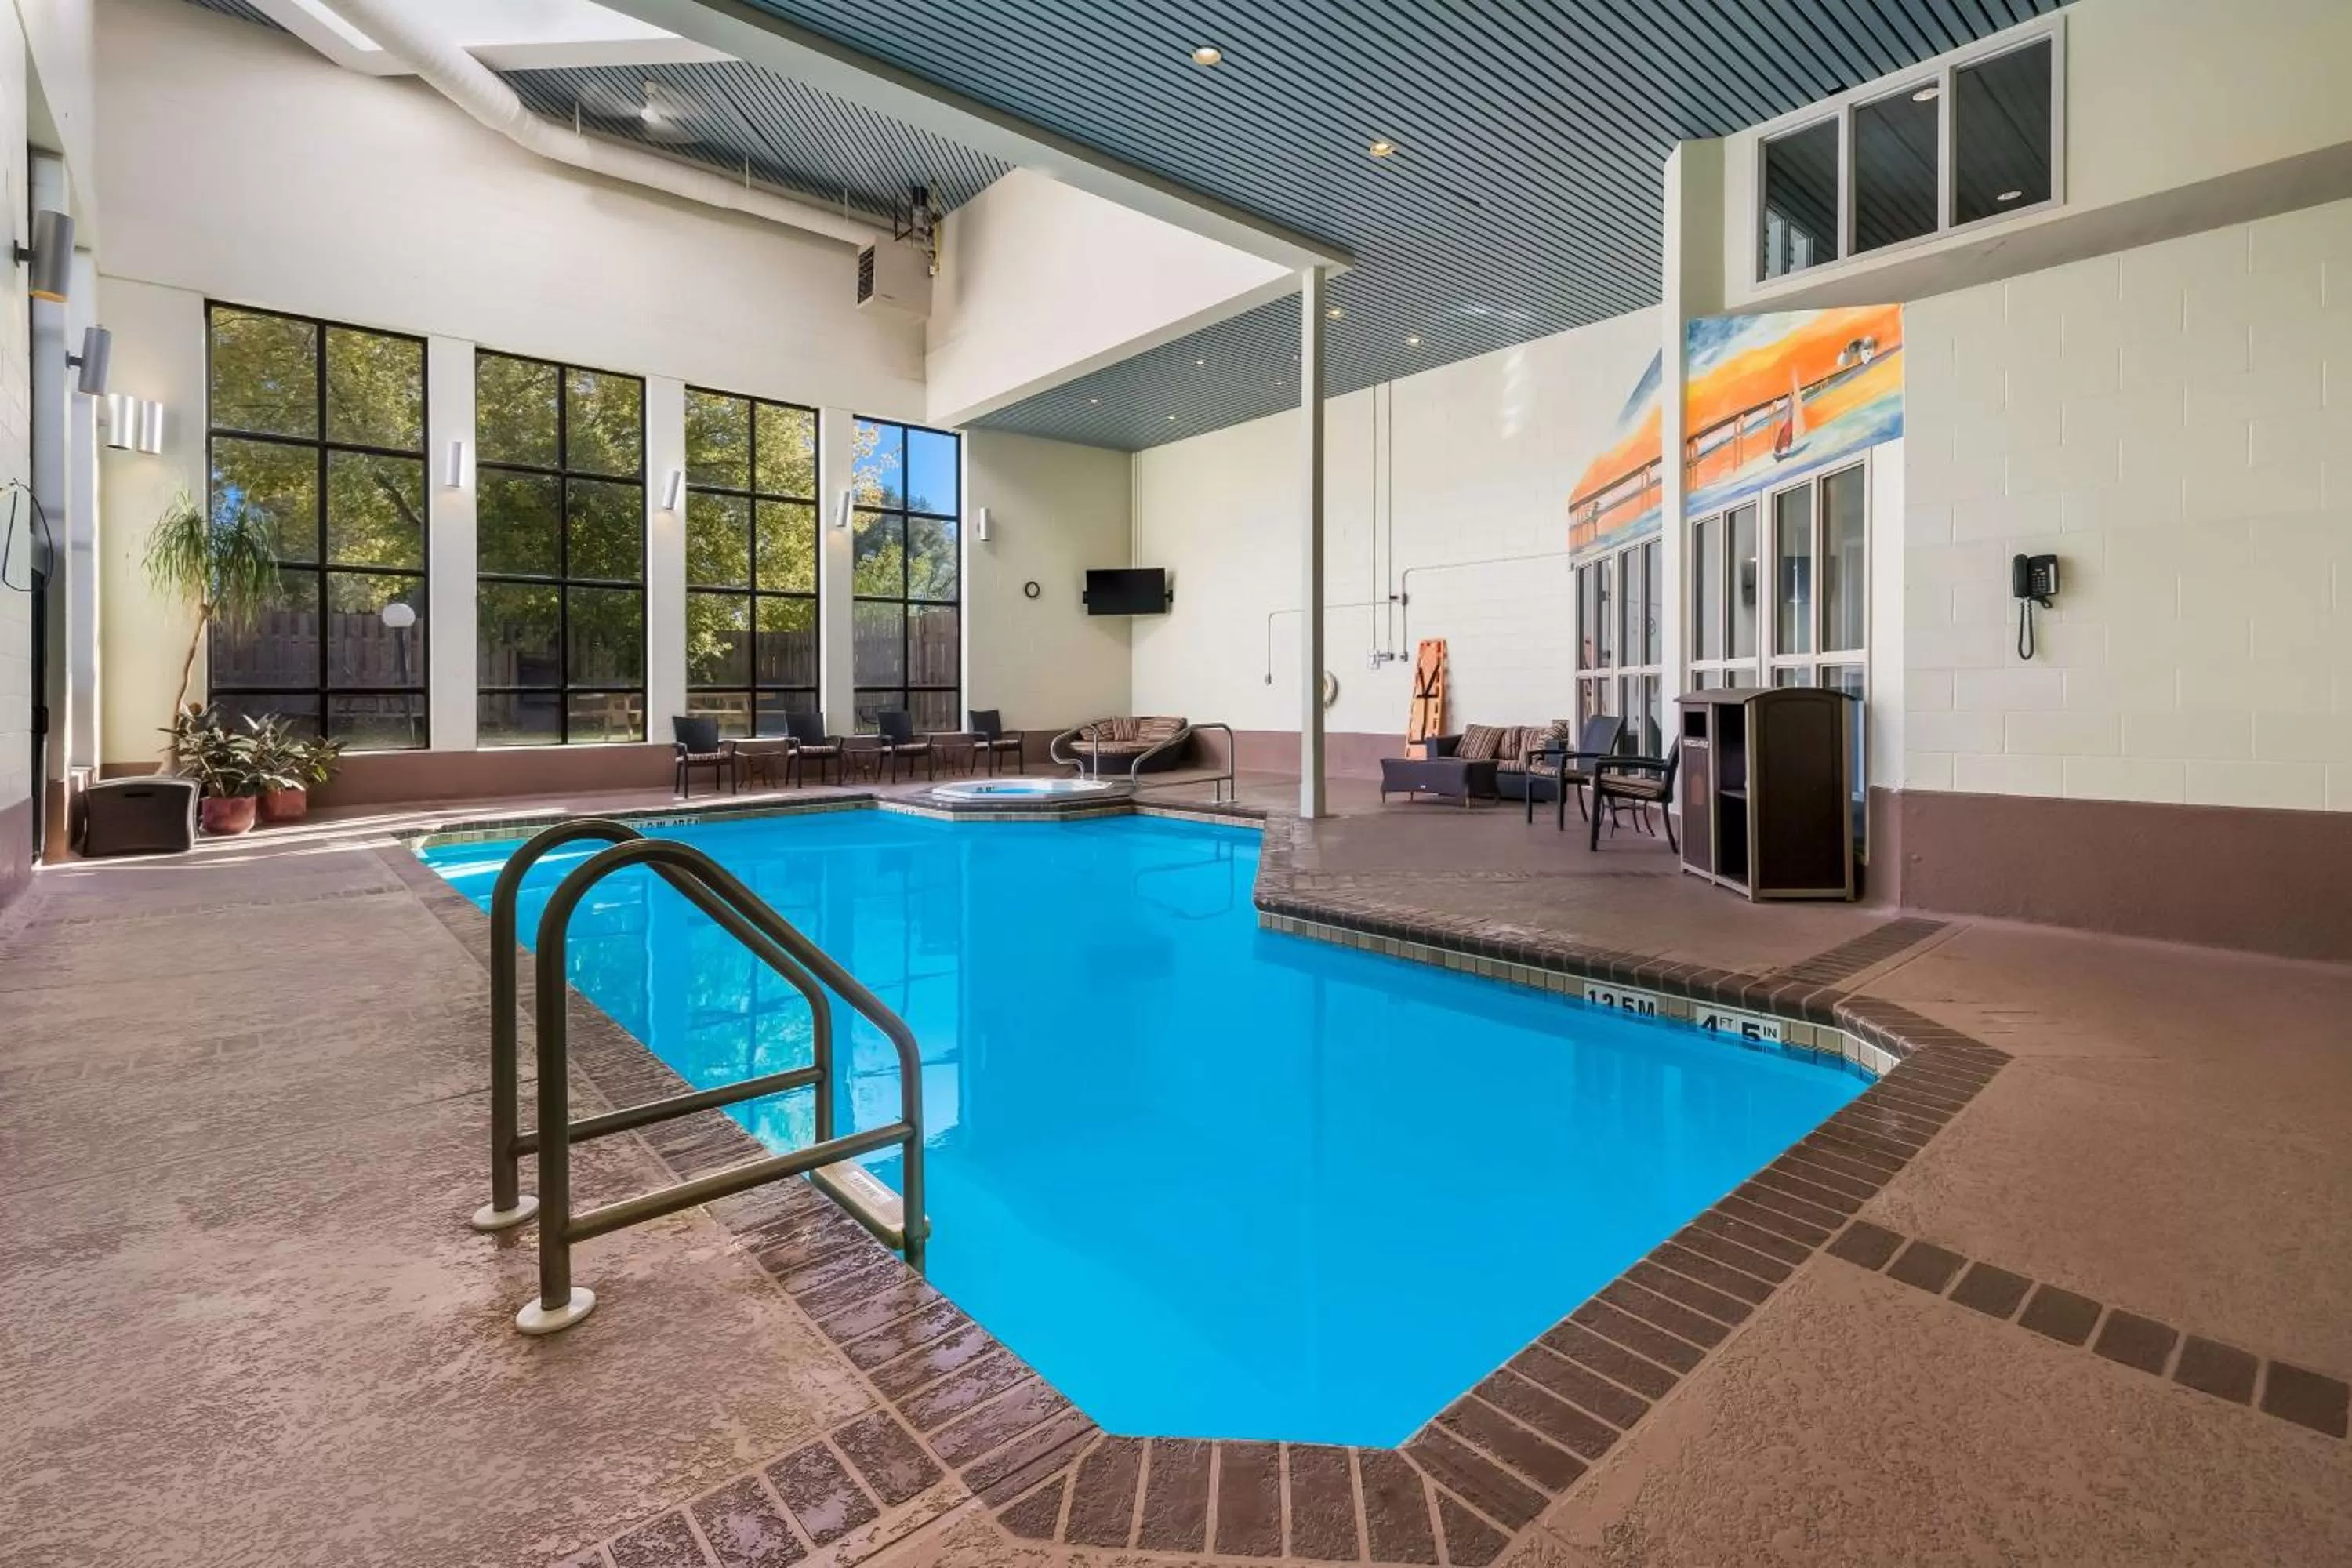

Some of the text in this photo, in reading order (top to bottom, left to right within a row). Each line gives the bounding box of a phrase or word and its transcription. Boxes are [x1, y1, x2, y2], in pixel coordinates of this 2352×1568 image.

[1700, 1015, 1717, 1032] 4
[1742, 1022, 1761, 1041] 5
[1763, 1026, 1777, 1038] IN
